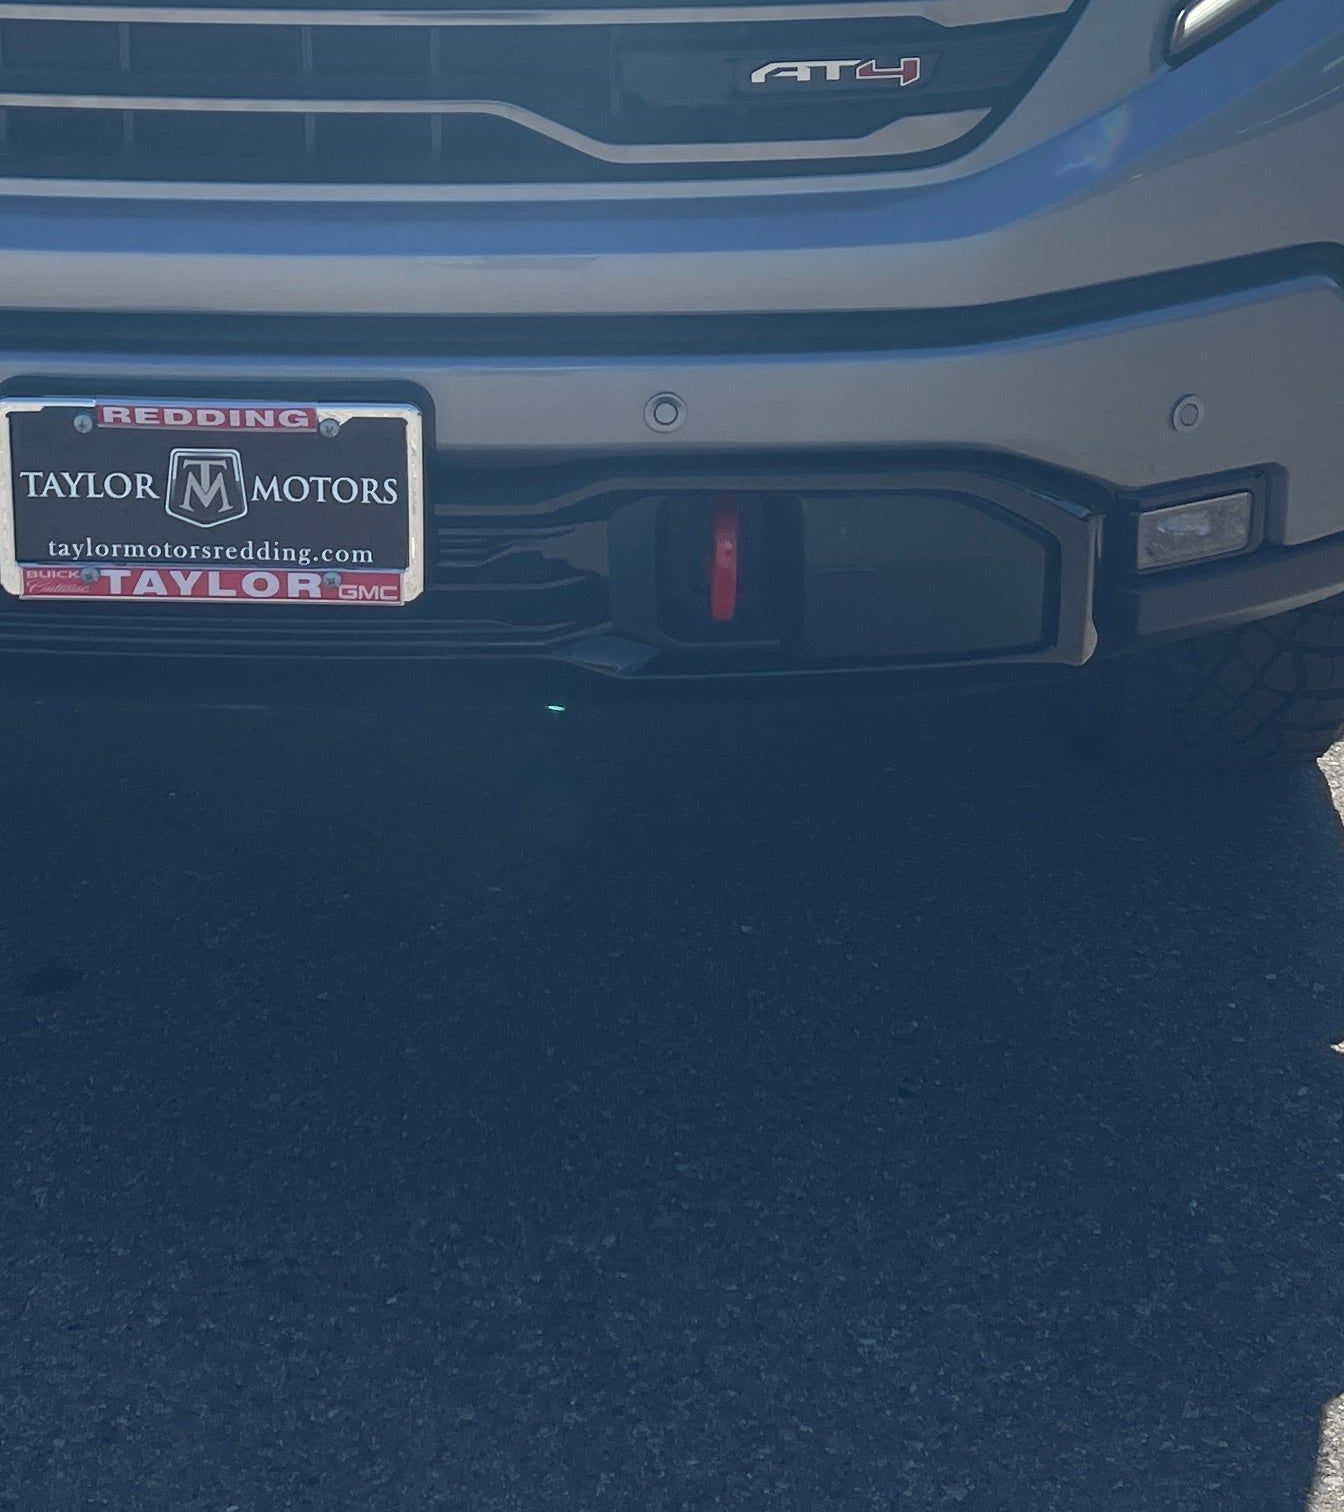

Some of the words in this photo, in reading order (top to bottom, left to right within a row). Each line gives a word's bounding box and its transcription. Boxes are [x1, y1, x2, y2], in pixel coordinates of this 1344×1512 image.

[750, 56, 921, 88] AT4
[102, 406, 310, 429] REDDING
[19, 471, 161, 500] TAYLOR
[250, 475, 398, 505] MOTORS
[48, 537, 374, 566] taylormotorsredding.com
[26, 569, 81, 579] BUICK
[100, 569, 323, 599] TAYLOR
[338, 584, 398, 600] GMC
